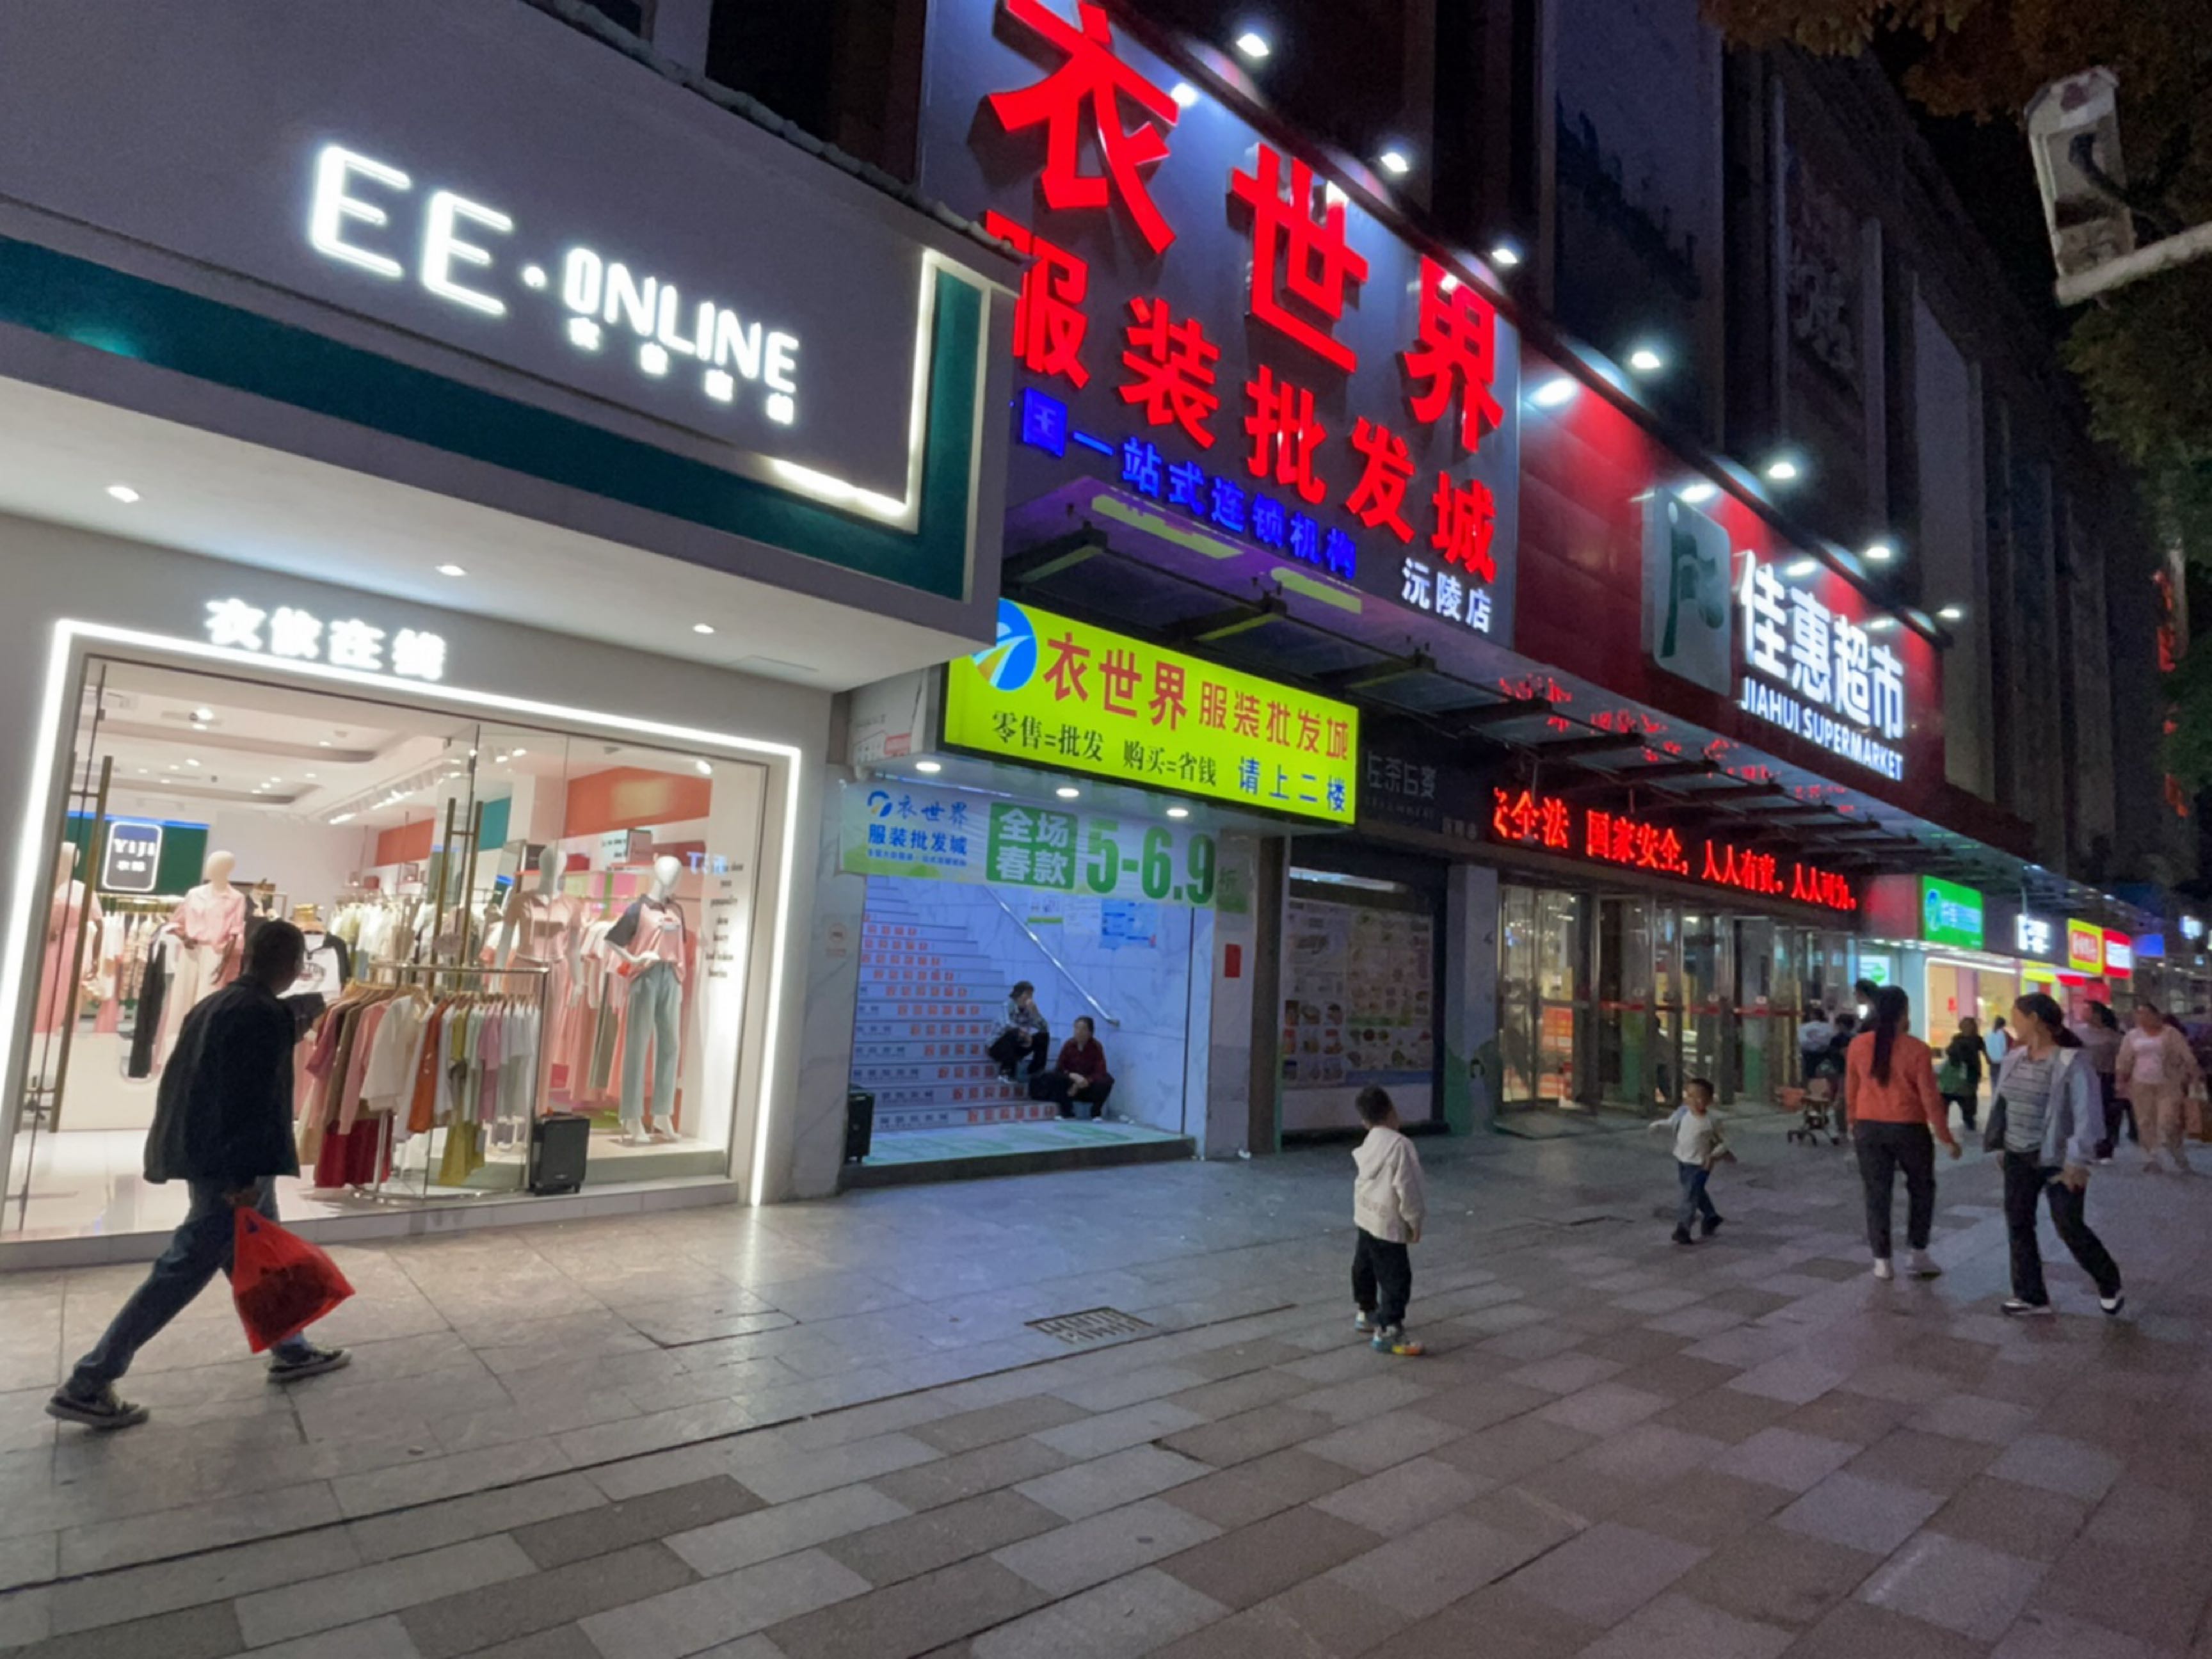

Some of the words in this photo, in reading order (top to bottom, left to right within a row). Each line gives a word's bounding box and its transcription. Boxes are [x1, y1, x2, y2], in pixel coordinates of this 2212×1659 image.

[312, 145, 513, 315] EE
[564, 247, 799, 394] ONLINE
[990, 0, 1503, 453] 衣世界
[986, 209, 1496, 583] 服装批发城
[1402, 556, 1492, 633] 沅陵店
[1740, 549, 1903, 739] 佳惠超市
[1044, 632, 1187, 732] 衣世界
[1198, 682, 1348, 760] 服装批发城
[1740, 676, 1799, 734] JIAHUI
[1802, 706, 1903, 781] SUPERMARKET
[897, 794, 968, 829] 衣世界
[993, 710, 1104, 762] 零售=批发
[1123, 739, 1216, 786] 购买=省钱
[1238, 755, 1345, 812] 请上二楼
[868, 823, 968, 856] 服装批发城
[996, 848, 1070, 887] 春款
[998, 812, 1070, 846] 全场
